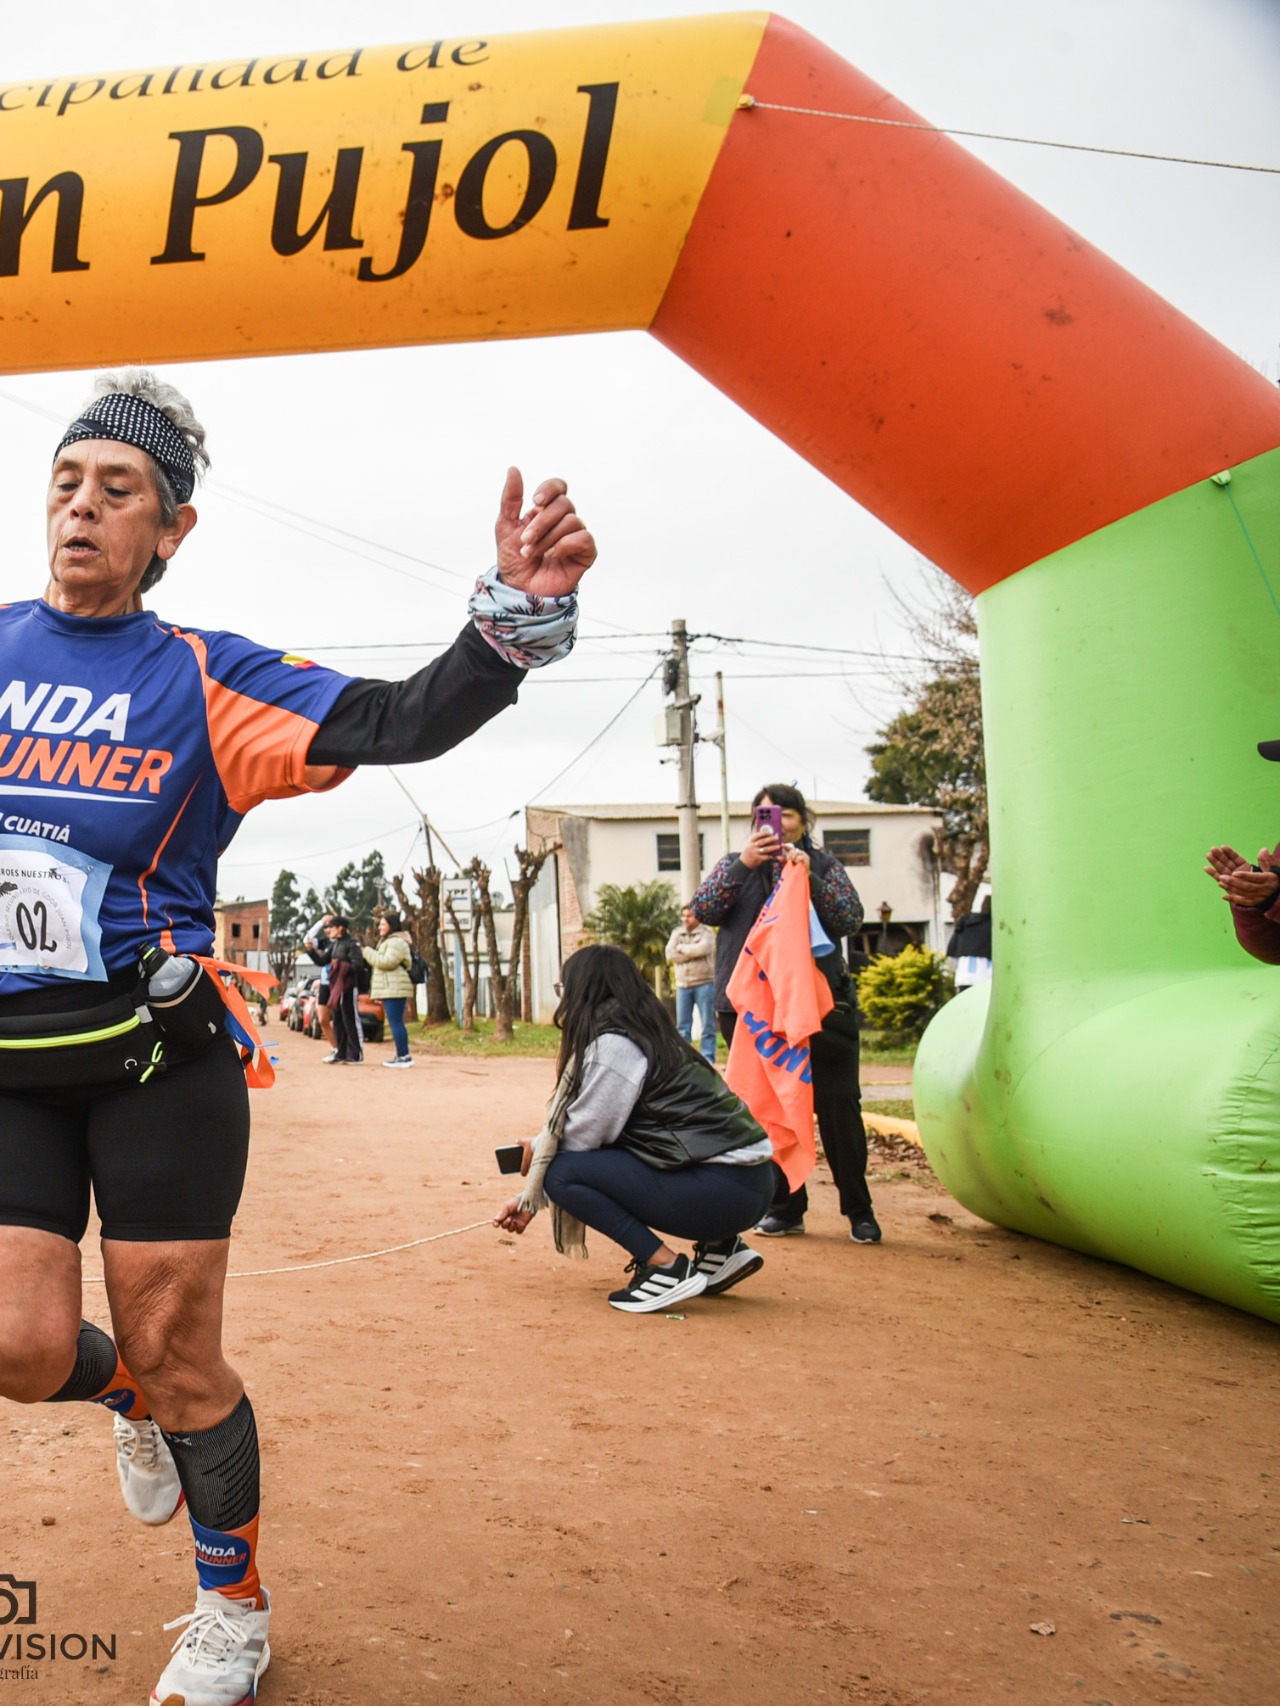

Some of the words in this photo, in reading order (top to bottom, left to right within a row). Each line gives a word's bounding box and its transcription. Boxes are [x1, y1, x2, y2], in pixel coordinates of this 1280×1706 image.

[395, 38, 492, 72] de
[150, 81, 621, 283] Pujol
[4, 815, 71, 844] CUATIÁ
[447, 888, 468, 896] YPF
[15, 900, 58, 953] 02
